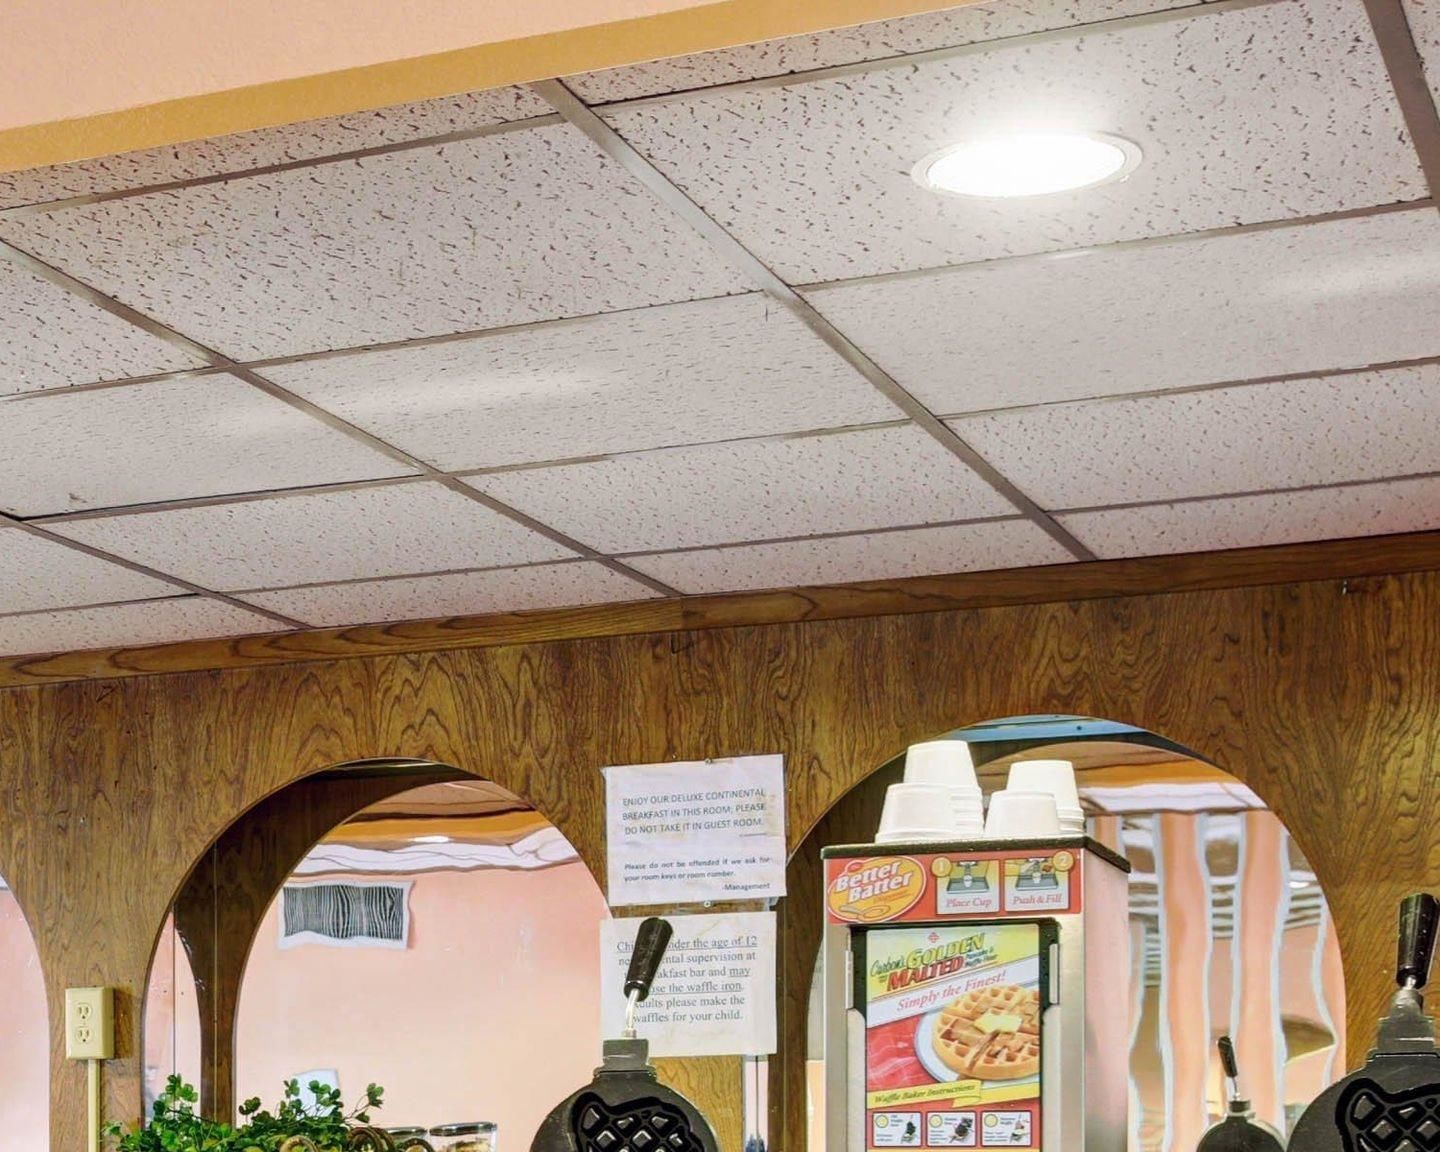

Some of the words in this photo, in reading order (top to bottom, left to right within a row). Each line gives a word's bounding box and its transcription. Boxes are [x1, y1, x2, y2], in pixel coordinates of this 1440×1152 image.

[623, 796, 648, 806] ENJOY
[650, 795, 669, 805] OUR
[671, 793, 703, 803] DELUXE
[705, 788, 766, 800] CONTINENTAL
[622, 810, 669, 820] BREAKFAST
[683, 807, 701, 816] THIS
[736, 803, 766, 812] PLEASE
[625, 827, 637, 835] DO
[639, 825, 658, 834] NOT
[660, 823, 681, 832] TAKE
[682, 823, 691, 831] IT
[692, 822, 702, 830] IN
[704, 820, 731, 830] GUEST
[689, 859, 720, 867] offended
[835, 862, 900, 892] Better
[848, 871, 913, 903] Batter
[946, 898, 971, 908] Place
[972, 898, 992, 908] Cup
[1012, 895, 1034, 904] Push
[1046, 894, 1063, 904] Fill
[694, 938, 708, 948] the
[711, 940, 729, 950] age
[731, 936, 742, 946] of
[746, 936, 758, 946] 12
[906, 932, 985, 968] GOLDEN
[686, 953, 743, 966] supervision
[746, 952, 756, 960] at
[690, 968, 705, 977] bar
[708, 967, 726, 976] and
[729, 968, 750, 978] may
[887, 956, 965, 992] MALTED
[668, 983, 685, 993] the
[686, 982, 718, 992] waffle
[896, 990, 938, 1012] Simply
[940, 983, 962, 1000] the
[964, 970, 1006, 992] Finest!
[666, 998, 698, 1009] please
[700, 996, 726, 1006] make
[730, 994, 745, 1005] the
[633, 1012, 669, 1023] waffles
[672, 1012, 686, 1022] for
[690, 1013, 712, 1024] your
[715, 1010, 743, 1020] child.
[874, 1093, 901, 1103] Waffle
[902, 1090, 926, 1100] Baker
[928, 1084, 976, 1096] Instructions
